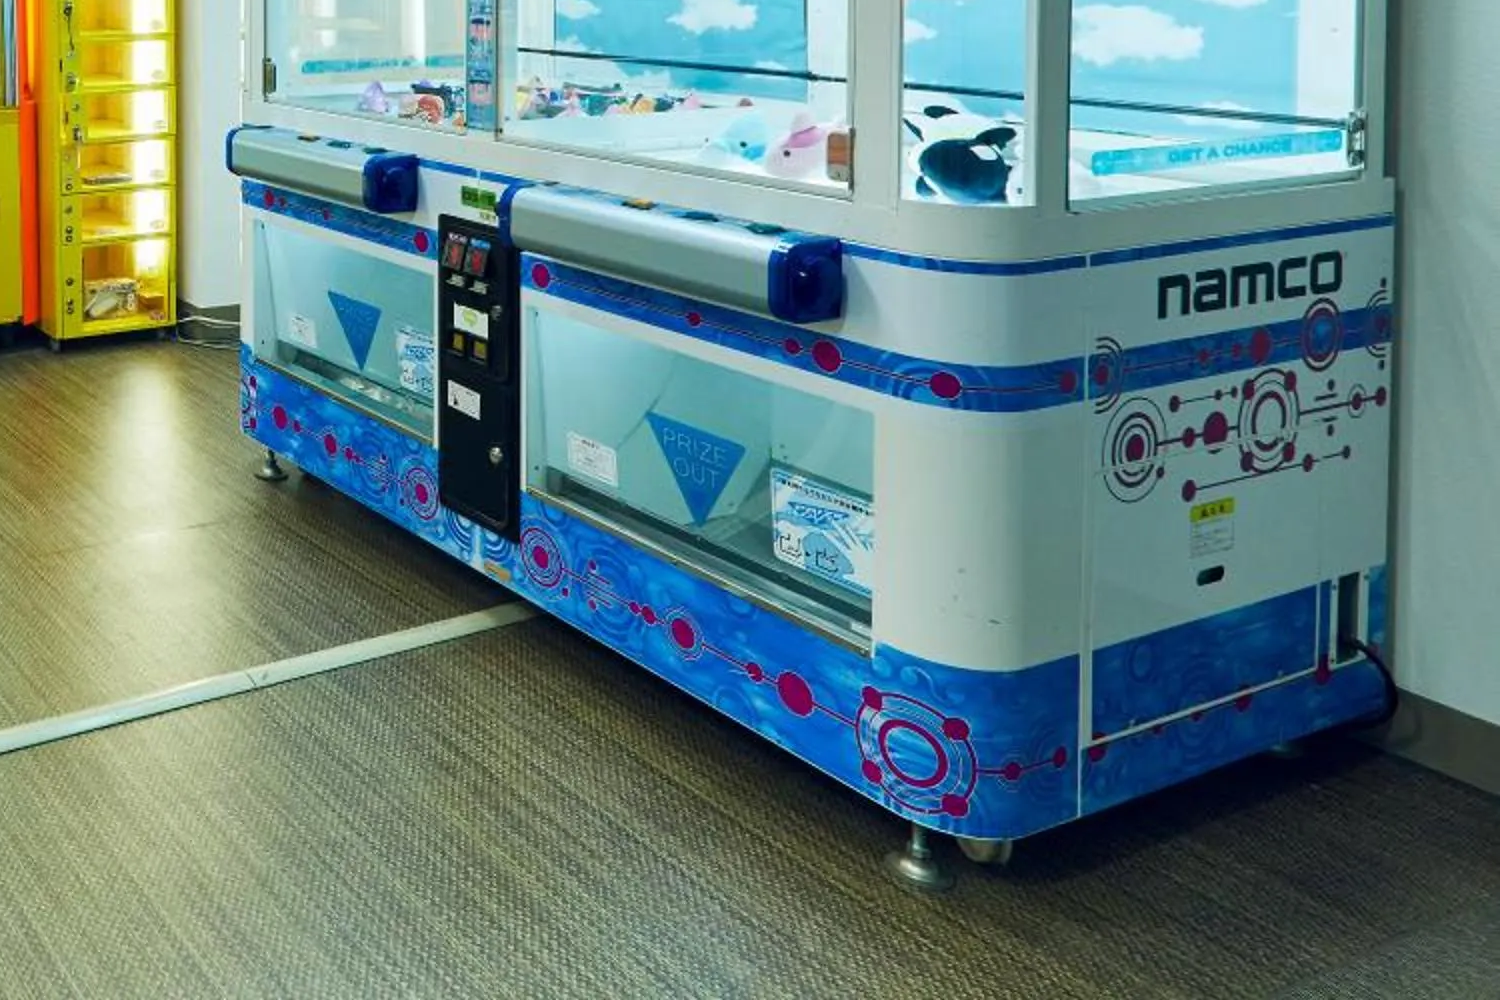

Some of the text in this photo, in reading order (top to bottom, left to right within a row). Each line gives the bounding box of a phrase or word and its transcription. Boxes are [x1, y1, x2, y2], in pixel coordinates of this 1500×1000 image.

[1157, 250, 1343, 320] namco
[662, 427, 726, 469] PRIZE
[673, 456, 720, 489] OUT
